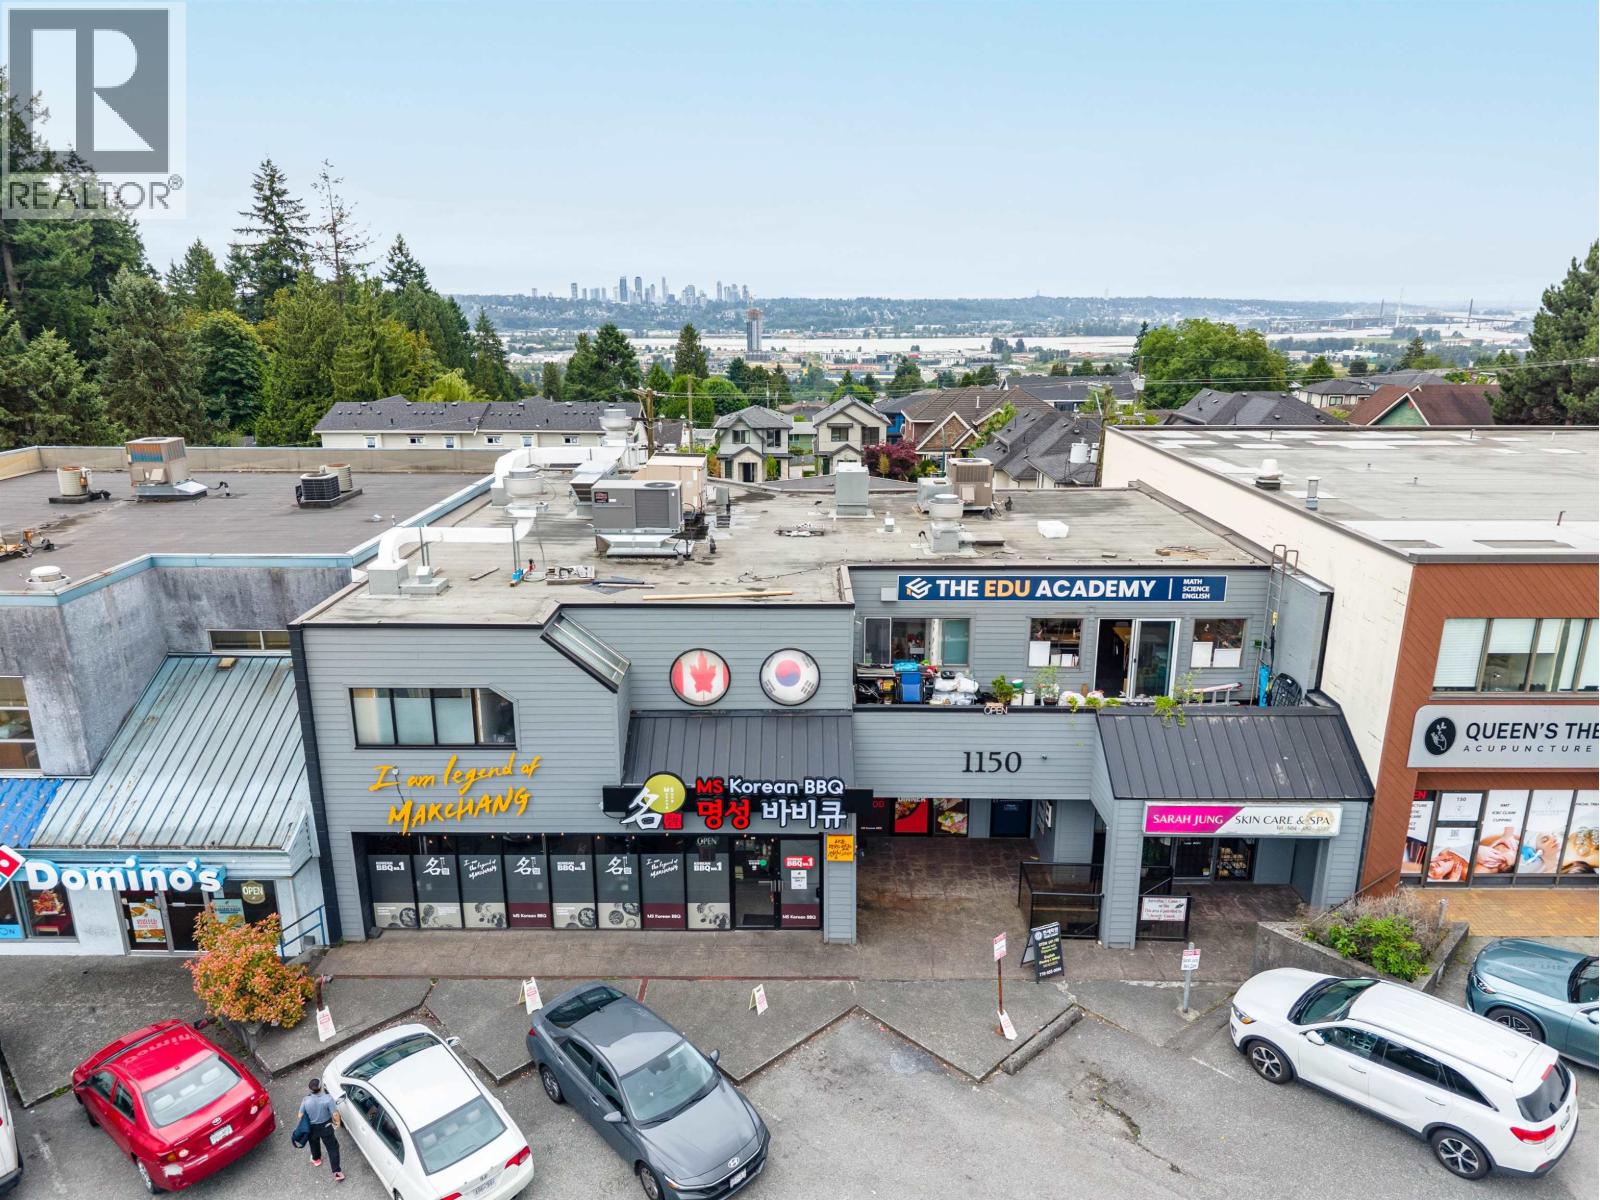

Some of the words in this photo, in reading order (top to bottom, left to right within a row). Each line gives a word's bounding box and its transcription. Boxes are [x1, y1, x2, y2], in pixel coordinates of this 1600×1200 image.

[936, 580, 979, 597] THE
[984, 580, 1030, 597] EDU
[1035, 580, 1156, 598] ACADEMY
[983, 705, 1008, 715] OPEN
[1466, 722, 1559, 740] QUEEN'S
[1463, 745, 1592, 753] ACUPUNCTURE
[961, 751, 1022, 773] 1150
[368, 765, 400, 792] I
[407, 774, 435, 788] am
[444, 752, 515, 795] legend
[521, 755, 542, 779] of
[696, 778, 724, 794] MS
[729, 778, 798, 794] Korean
[804, 779, 844, 794] BBQ
[387, 787, 532, 836] MAKCHANG
[620, 786, 662, 830] 名
[697, 799, 750, 829] 명성
[761, 799, 847, 829] 바비큐
[1153, 815, 1190, 824] SARAH
[1192, 815, 1224, 826] JUNG
[1235, 815, 1260, 824] SKIN
[1263, 815, 1293, 824] CARE
[1296, 816, 1304, 824] &
[1309, 816, 1330, 825] SPA
[697, 836, 717, 845] OPEN
[24, 855, 222, 892] Domino's
[557, 864, 574, 872] BBQ
[242, 885, 263, 896] OPEN
